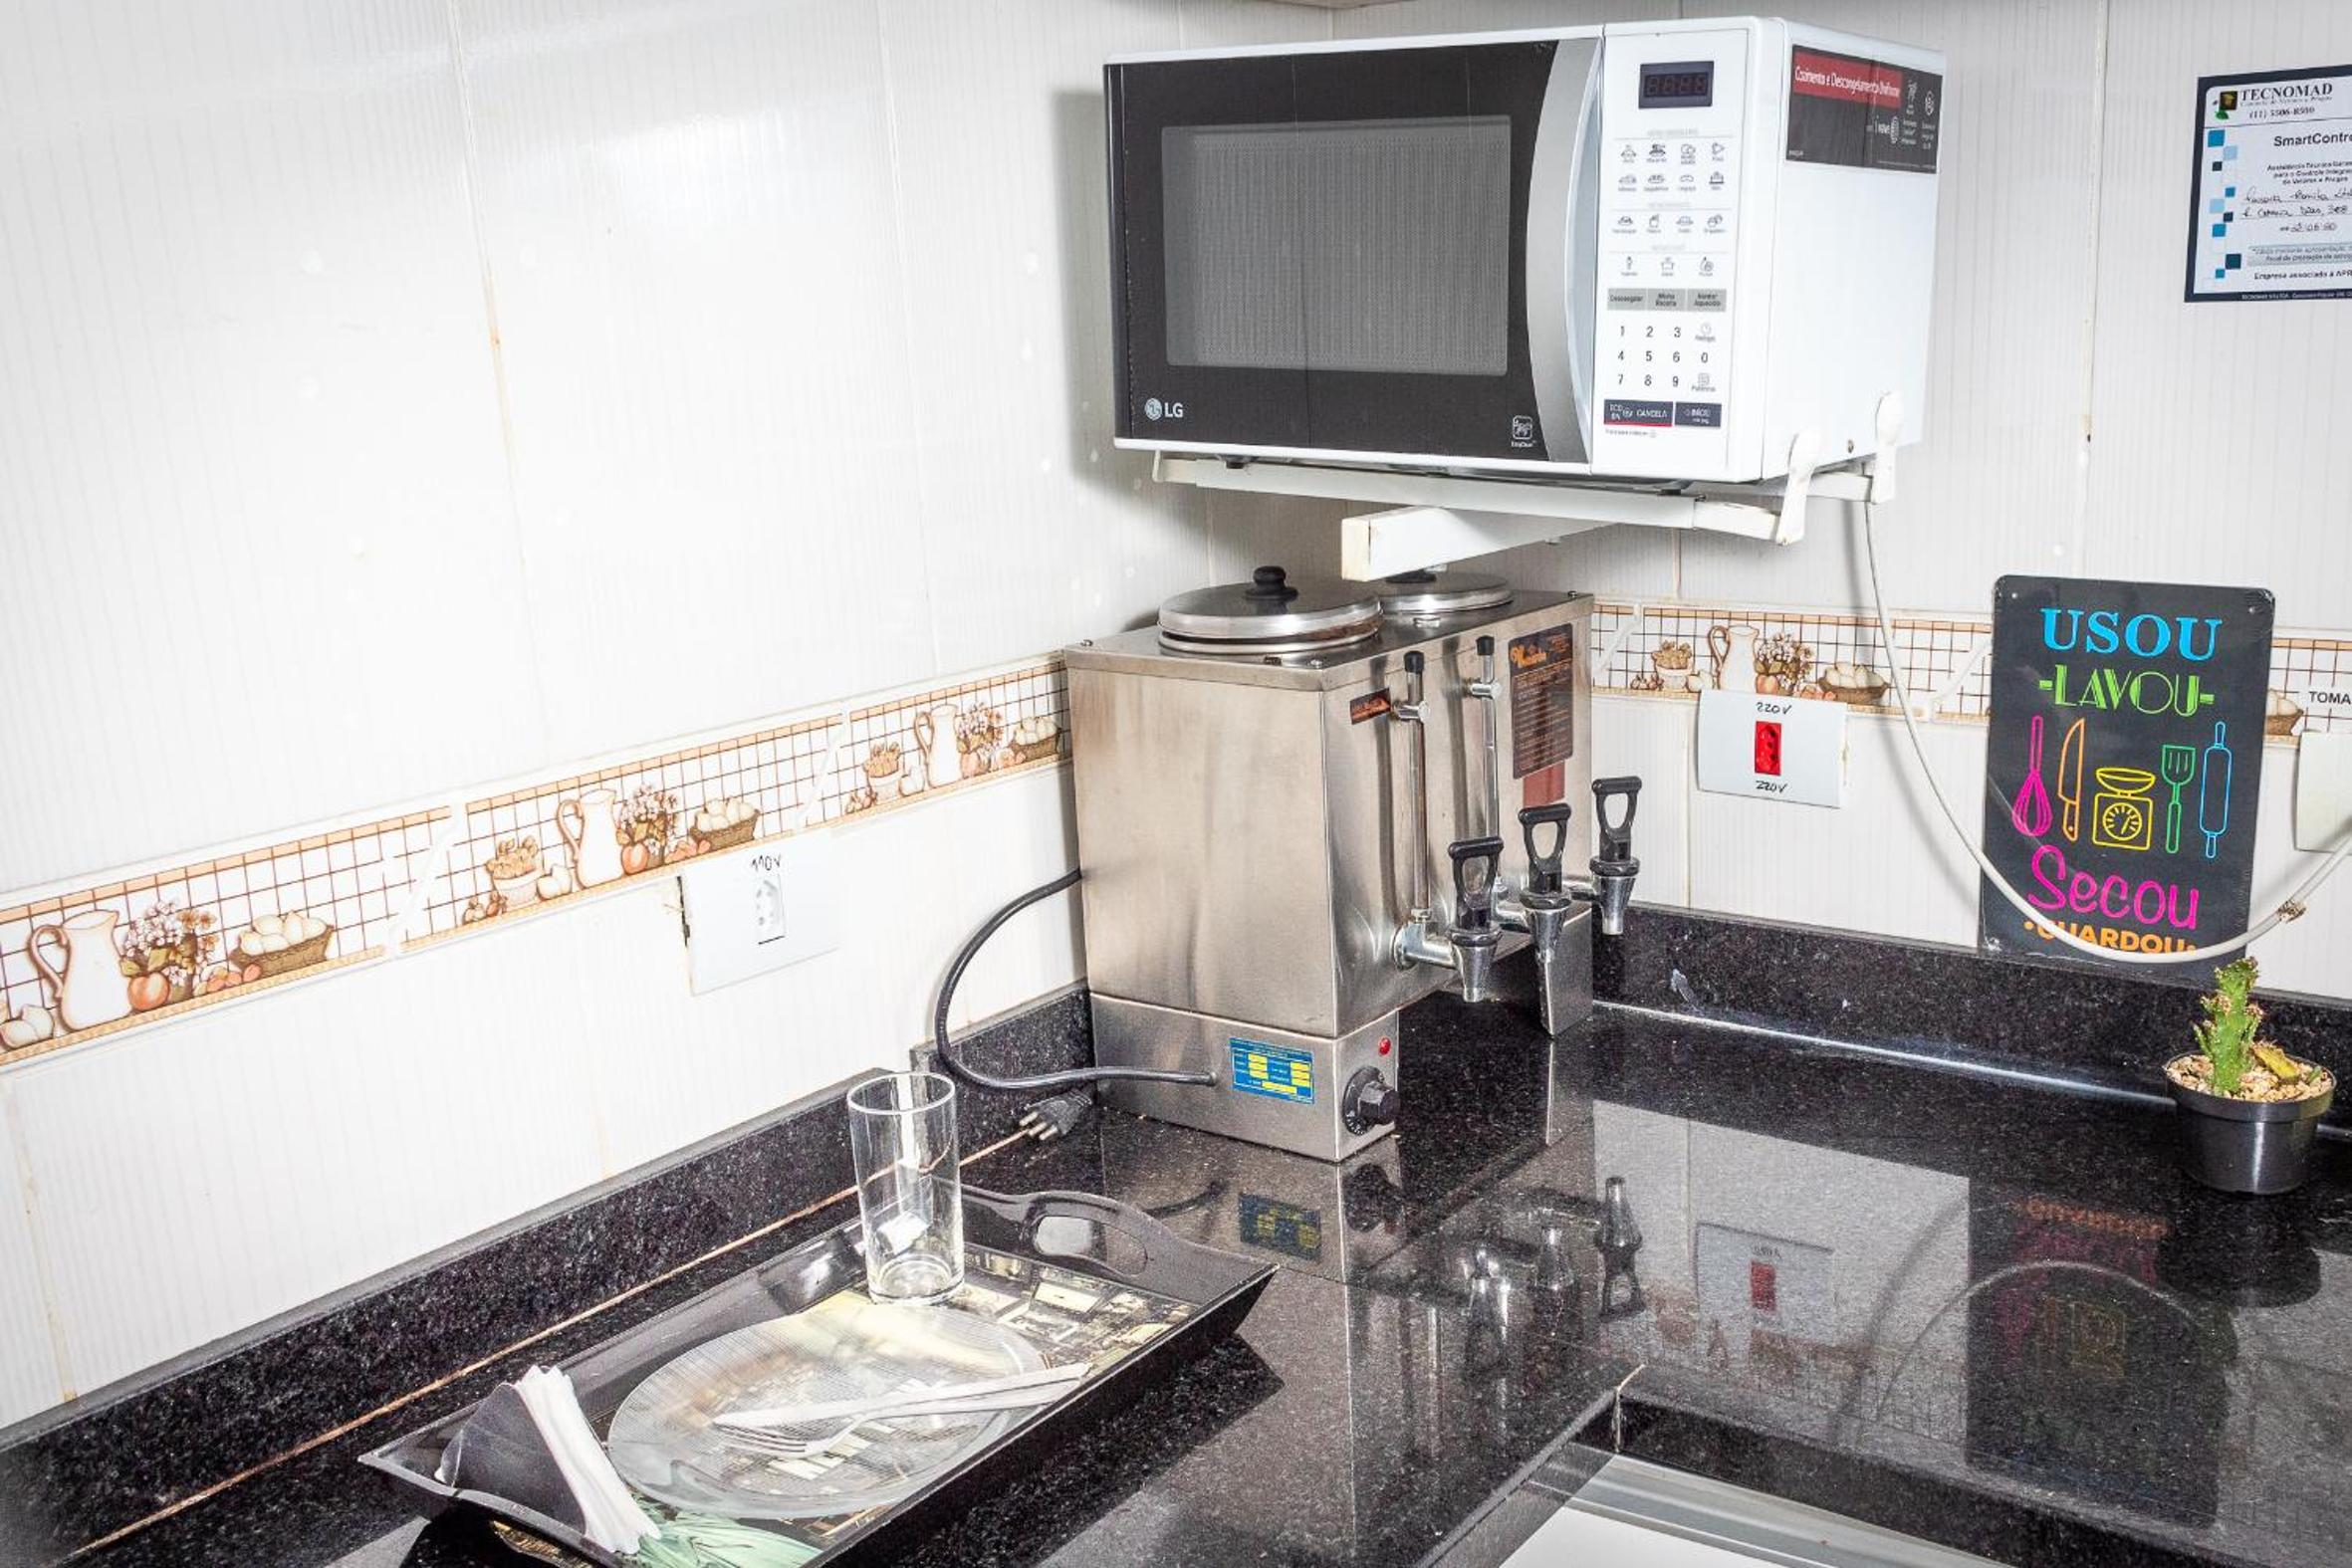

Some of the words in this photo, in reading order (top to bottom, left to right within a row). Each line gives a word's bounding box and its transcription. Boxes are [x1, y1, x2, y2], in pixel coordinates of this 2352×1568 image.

[2239, 83, 2332, 101] TECNOMAD
[1646, 326, 1654, 337] 2
[1674, 327, 1681, 337] 3
[1618, 350, 1624, 360] 4
[1645, 350, 1653, 361] 5
[1673, 351, 1680, 362] 6
[1701, 352, 1709, 363] 0
[1618, 374, 1624, 385] 7
[1644, 374, 1652, 386] 8
[1673, 376, 1679, 387] 9
[1164, 402, 1183, 418] LG
[2039, 608, 2223, 661] USOU
[2027, 844, 2200, 929] Secou
